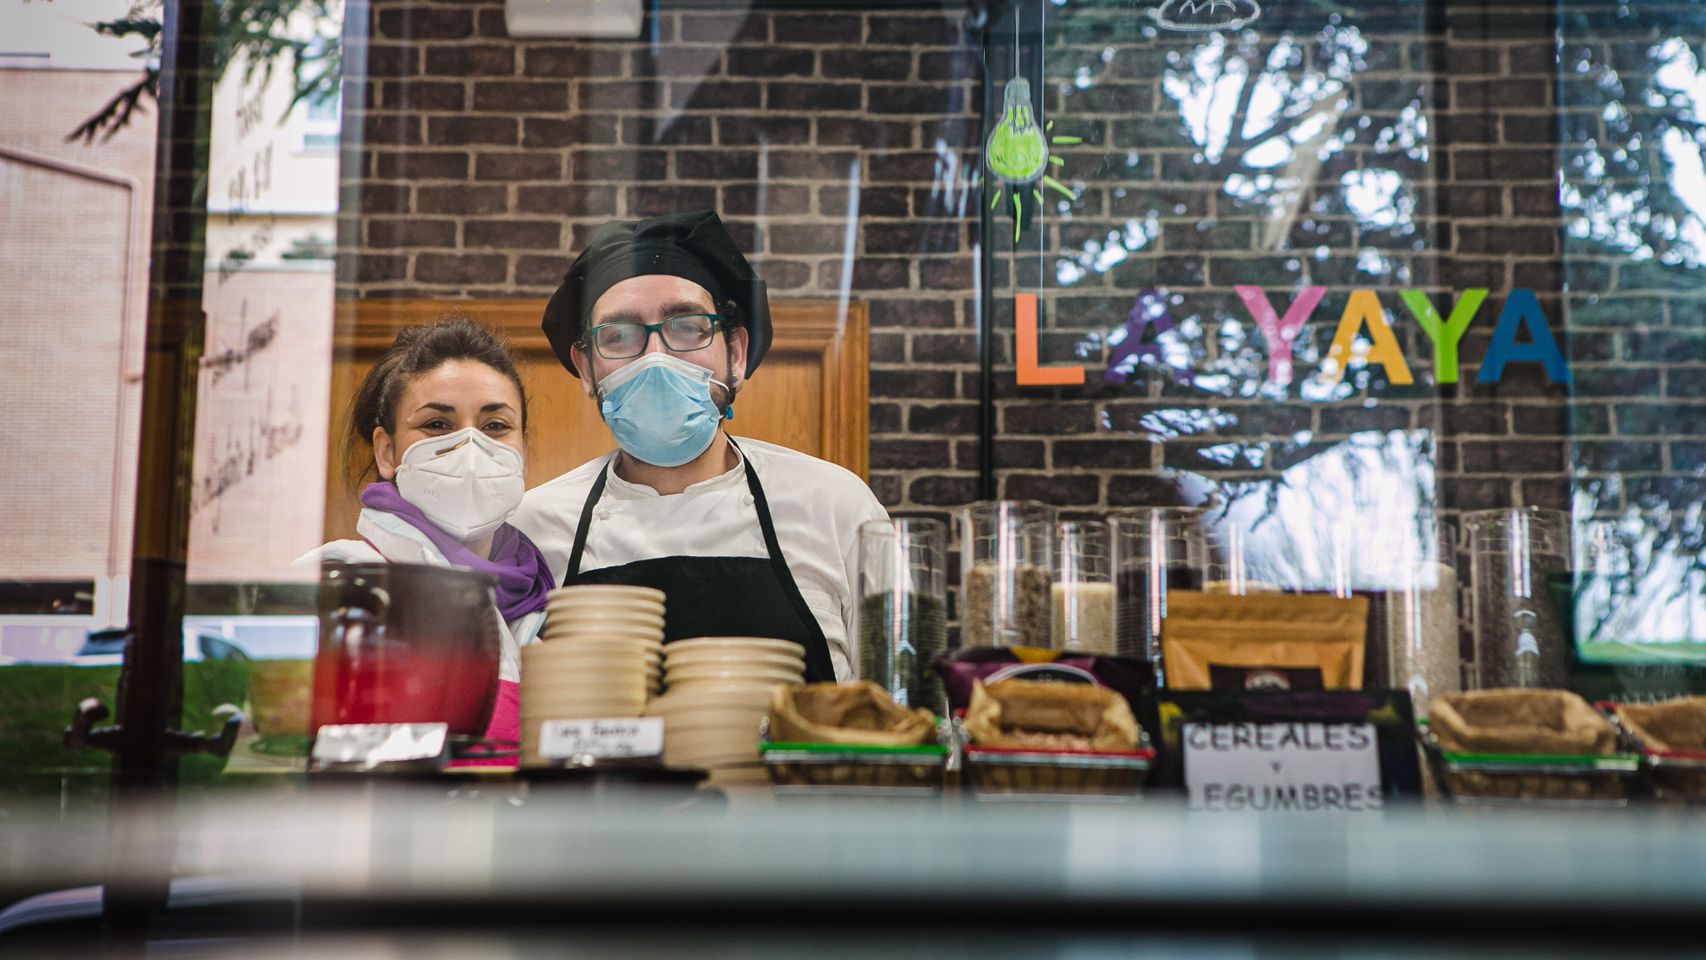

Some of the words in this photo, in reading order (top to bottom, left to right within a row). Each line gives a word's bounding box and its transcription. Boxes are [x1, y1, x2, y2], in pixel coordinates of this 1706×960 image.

[1014, 288, 1195, 386] LA
[1234, 284, 1571, 385] YAYA
[1187, 723, 1371, 751] CEREALES
